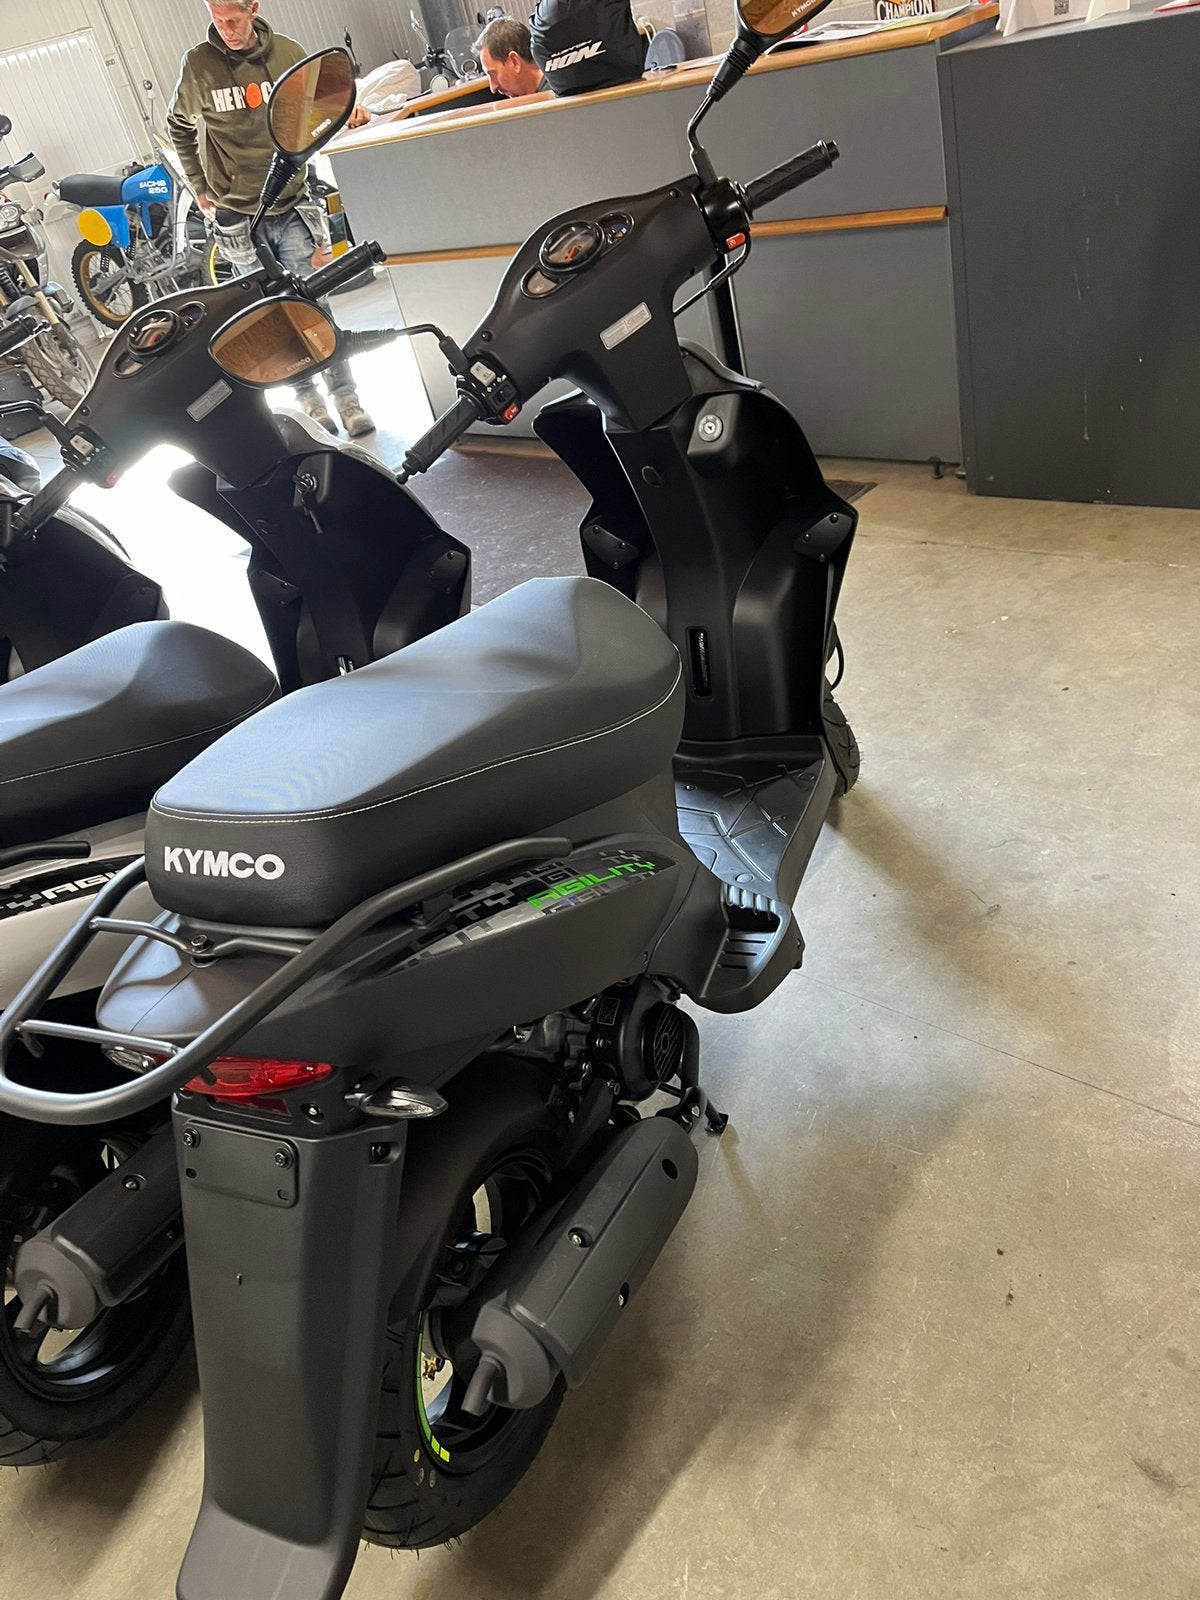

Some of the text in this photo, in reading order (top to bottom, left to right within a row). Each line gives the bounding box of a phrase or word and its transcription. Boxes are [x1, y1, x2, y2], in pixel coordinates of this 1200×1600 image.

[876, 0, 934, 20] CHAMPION
[211, 81, 277, 112] HEROC
[139, 180, 167, 188] SACHS
[164, 846, 286, 880] KYMCO
[527, 861, 656, 908] AGILITY
